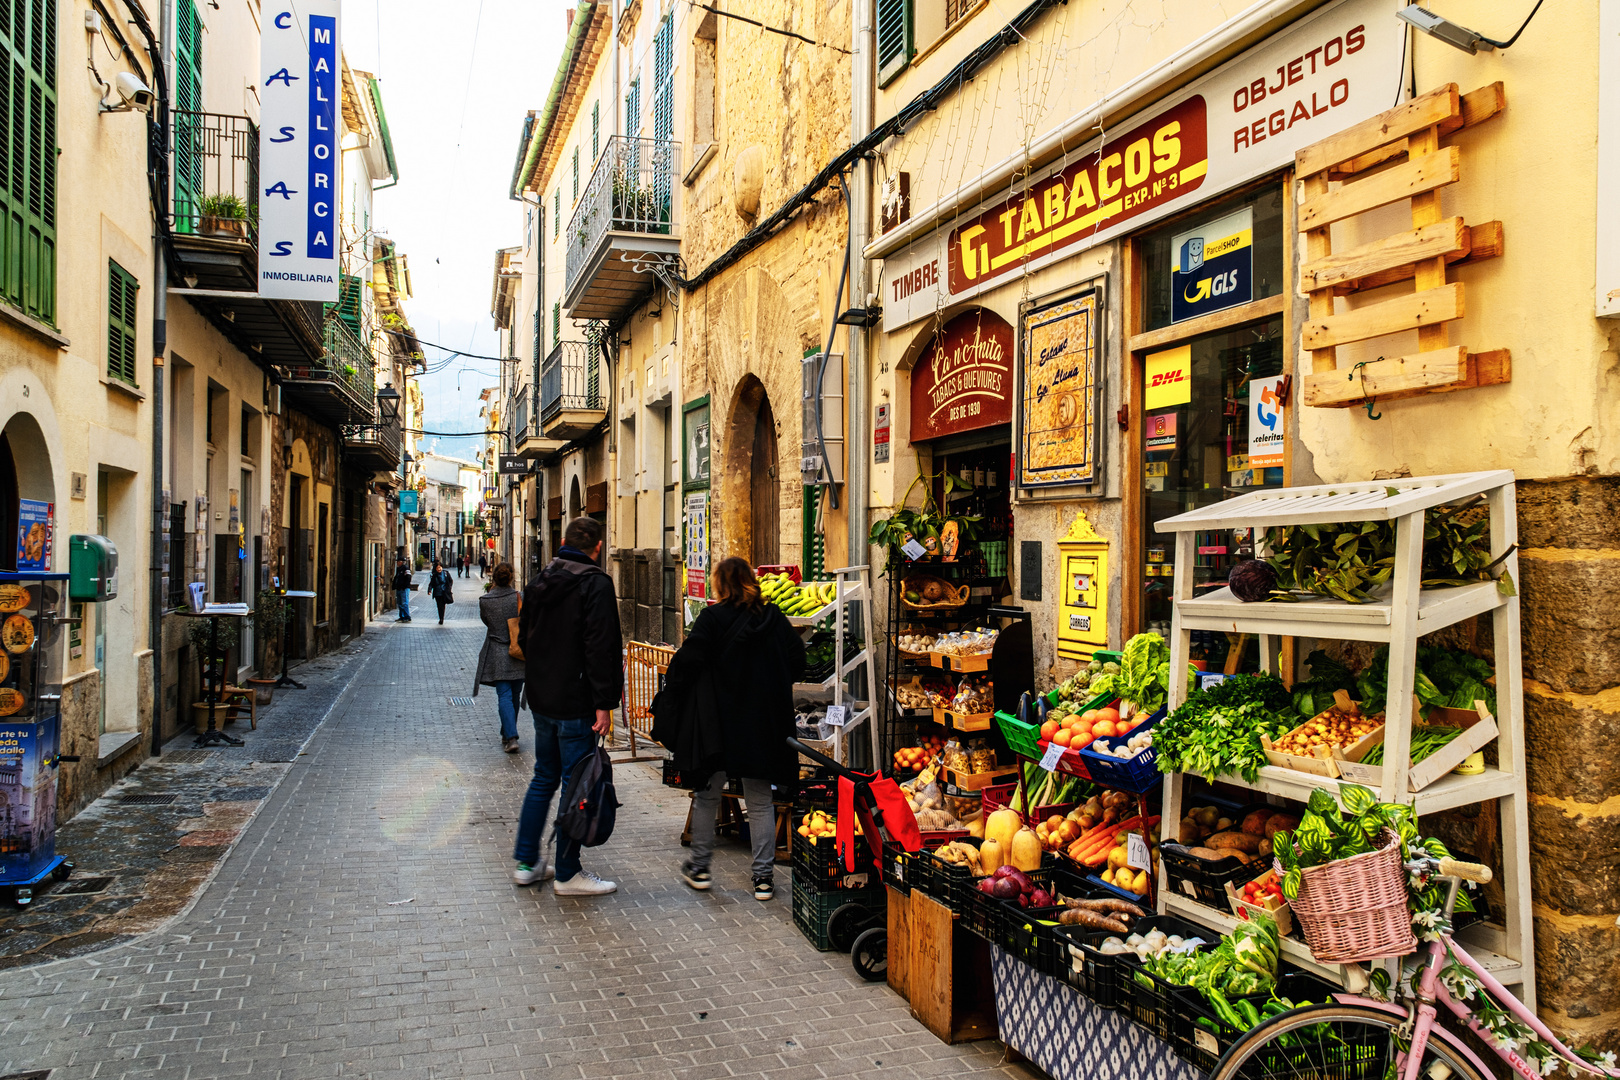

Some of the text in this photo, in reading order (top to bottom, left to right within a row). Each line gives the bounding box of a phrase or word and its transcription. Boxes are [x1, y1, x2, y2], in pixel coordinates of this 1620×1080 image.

[1233, 24, 1366, 113] OBJETOS
[264, 11, 300, 257] CASAS
[1233, 78, 1349, 154] REGALO
[313, 27, 331, 247] MALLORCA
[999, 120, 1181, 248] TABACOS
[1124, 186, 1152, 211] EXP.
[1168, 172, 1178, 190] 3
[262, 271, 334, 284] INMOBILIARIA
[892, 258, 938, 303] TIMBRE
[1211, 268, 1238, 297] GLS
[932, 376, 956, 408] TABACS
[963, 370, 1002, 392] QUEVIURES
[1151, 369, 1185, 387] DHL
[967, 401, 980, 416] 1930
[1070, 617, 1088, 629] CORREOS
